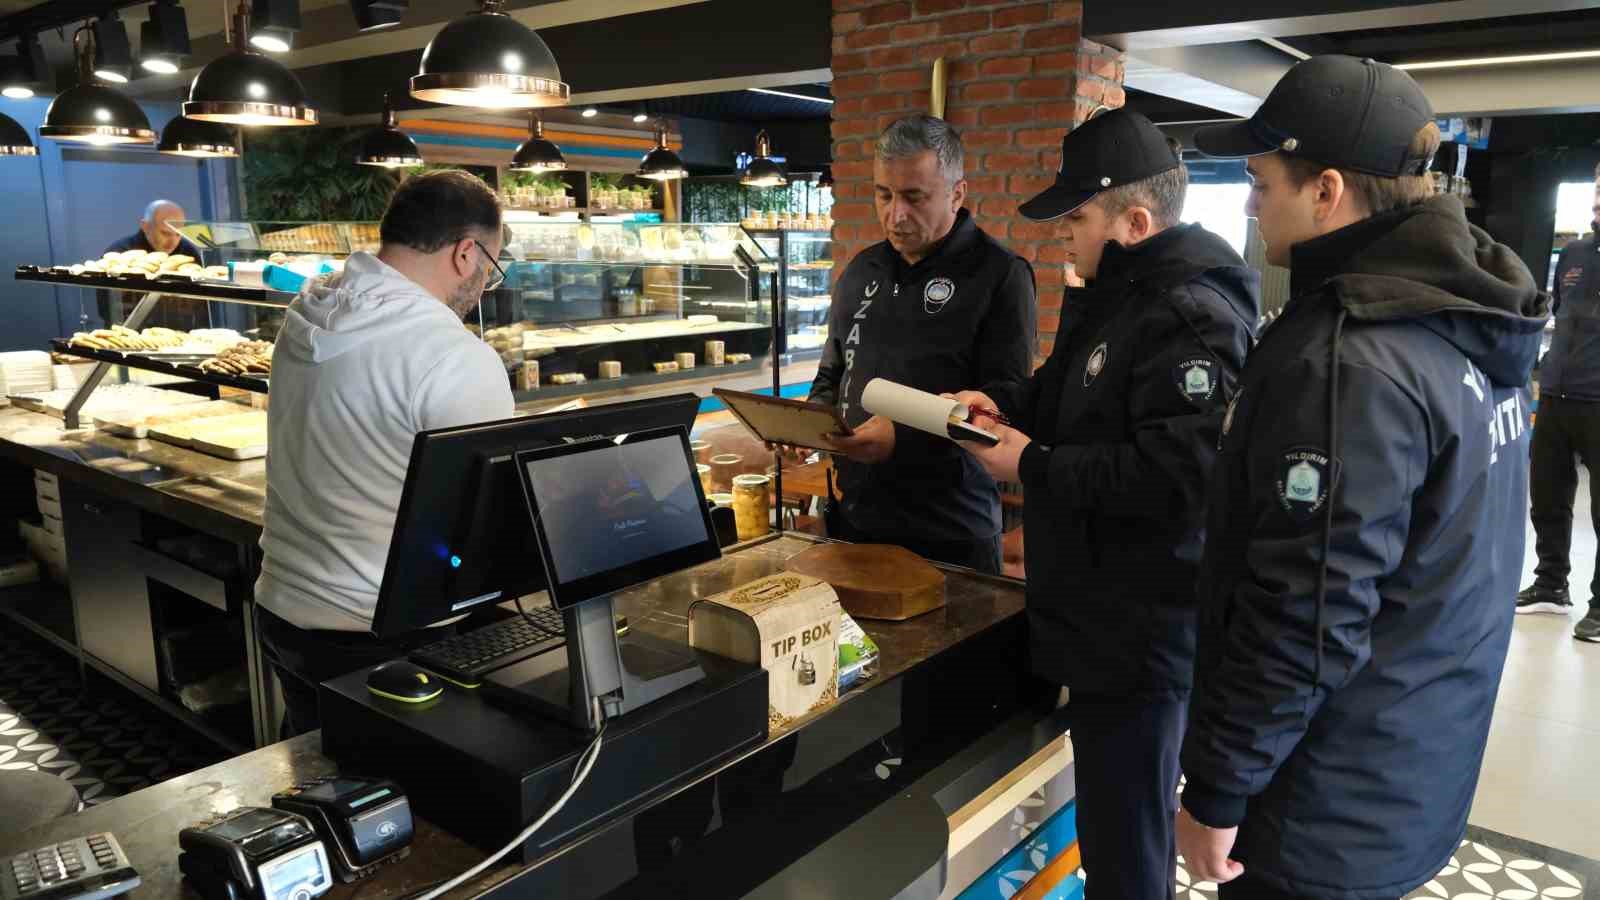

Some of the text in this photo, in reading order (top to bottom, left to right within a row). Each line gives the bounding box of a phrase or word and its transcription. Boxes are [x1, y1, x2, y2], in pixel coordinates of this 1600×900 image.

[1284, 452, 1329, 466] YILDIRIM
[771, 636, 797, 658] TIP
[801, 621, 832, 647] BOX
